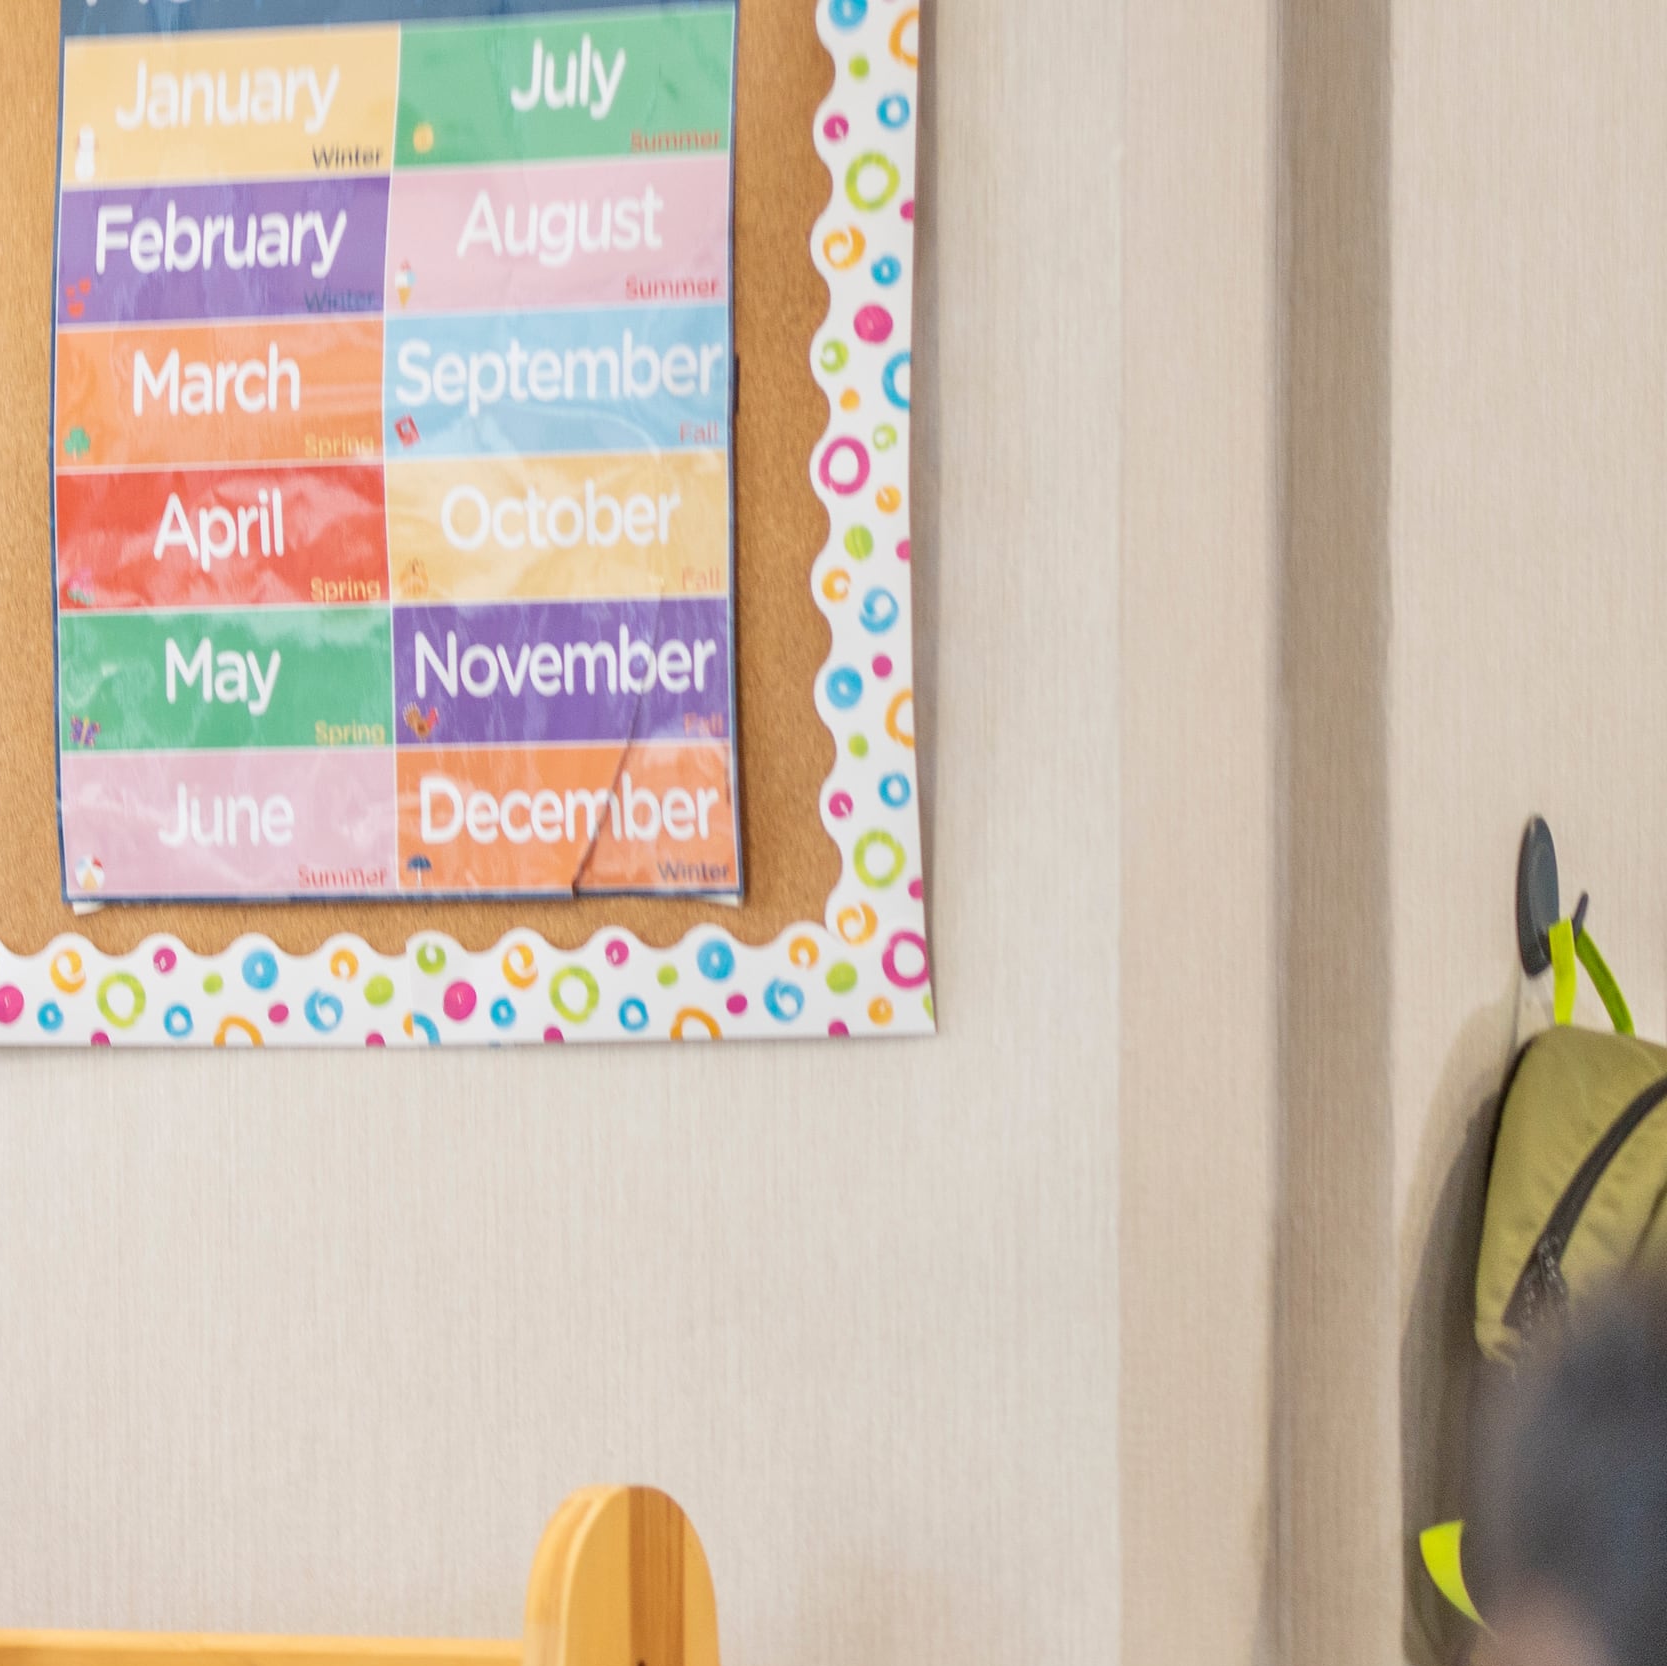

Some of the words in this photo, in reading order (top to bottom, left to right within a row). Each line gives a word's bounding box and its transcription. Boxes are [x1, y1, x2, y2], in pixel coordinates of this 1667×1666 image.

[115, 58, 340, 132] January
[510, 34, 625, 120] July
[313, 146, 383, 170] Winter
[630, 131, 721, 153] Summer
[95, 199, 347, 277] February
[456, 184, 663, 267] August
[303, 288, 376, 313] Winter
[625, 276, 719, 298] Summer
[133, 342, 300, 416] March
[395, 329, 722, 416] September
[304, 434, 374, 458] Spring
[680, 423, 719, 444] Fall
[153, 489, 284, 571] April
[441, 482, 681, 548] October
[310, 577, 381, 605] Spring
[682, 568, 720, 590] Fall
[166, 638, 281, 715] May
[414, 625, 717, 697] November
[315, 721, 385, 746] Spring
[684, 714, 723, 736] Fall
[158, 782, 295, 848] June
[419, 773, 718, 846] December
[298, 867, 387, 888] Summer
[657, 860, 730, 882] Winter
